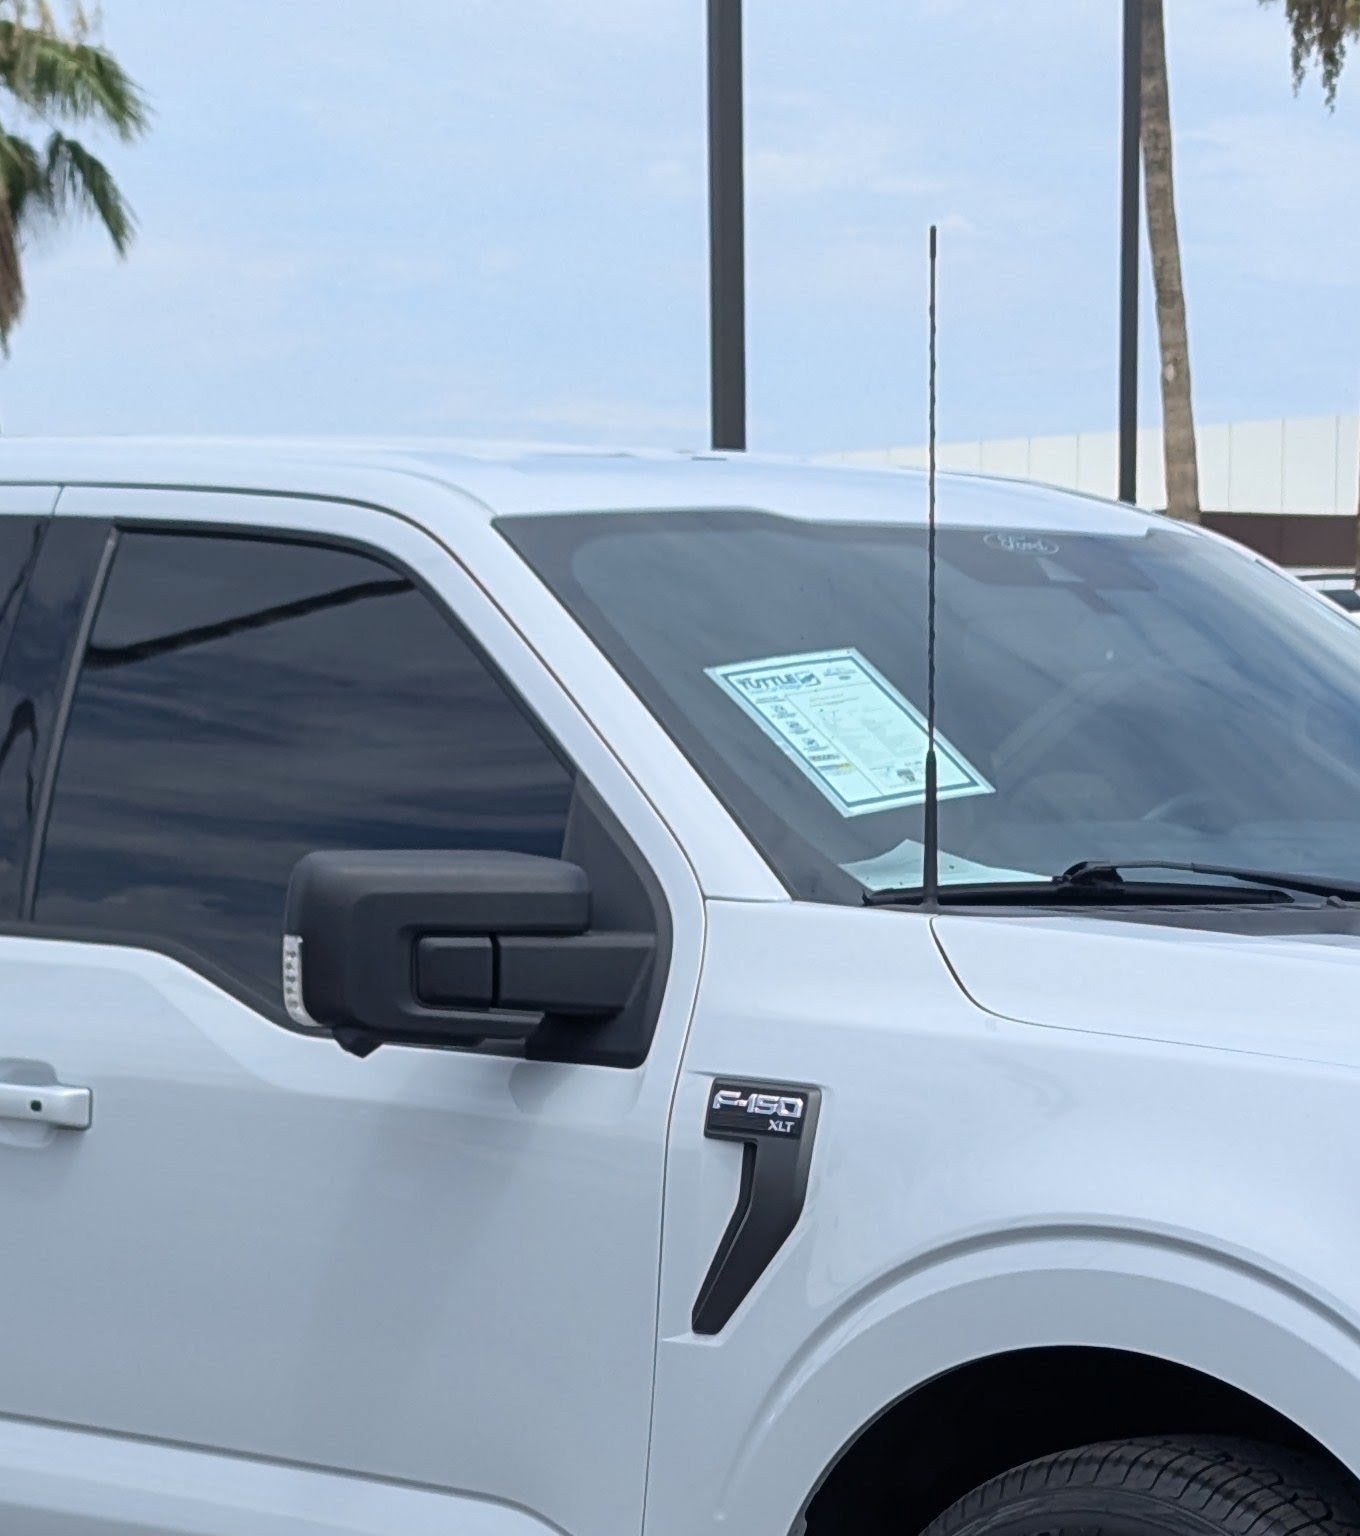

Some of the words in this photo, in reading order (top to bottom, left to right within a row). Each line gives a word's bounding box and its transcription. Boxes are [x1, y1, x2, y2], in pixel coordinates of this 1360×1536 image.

[737, 673, 797, 690] TUTTLE
[712, 1089, 804, 1118] F-150
[767, 1119, 795, 1133] XLT
